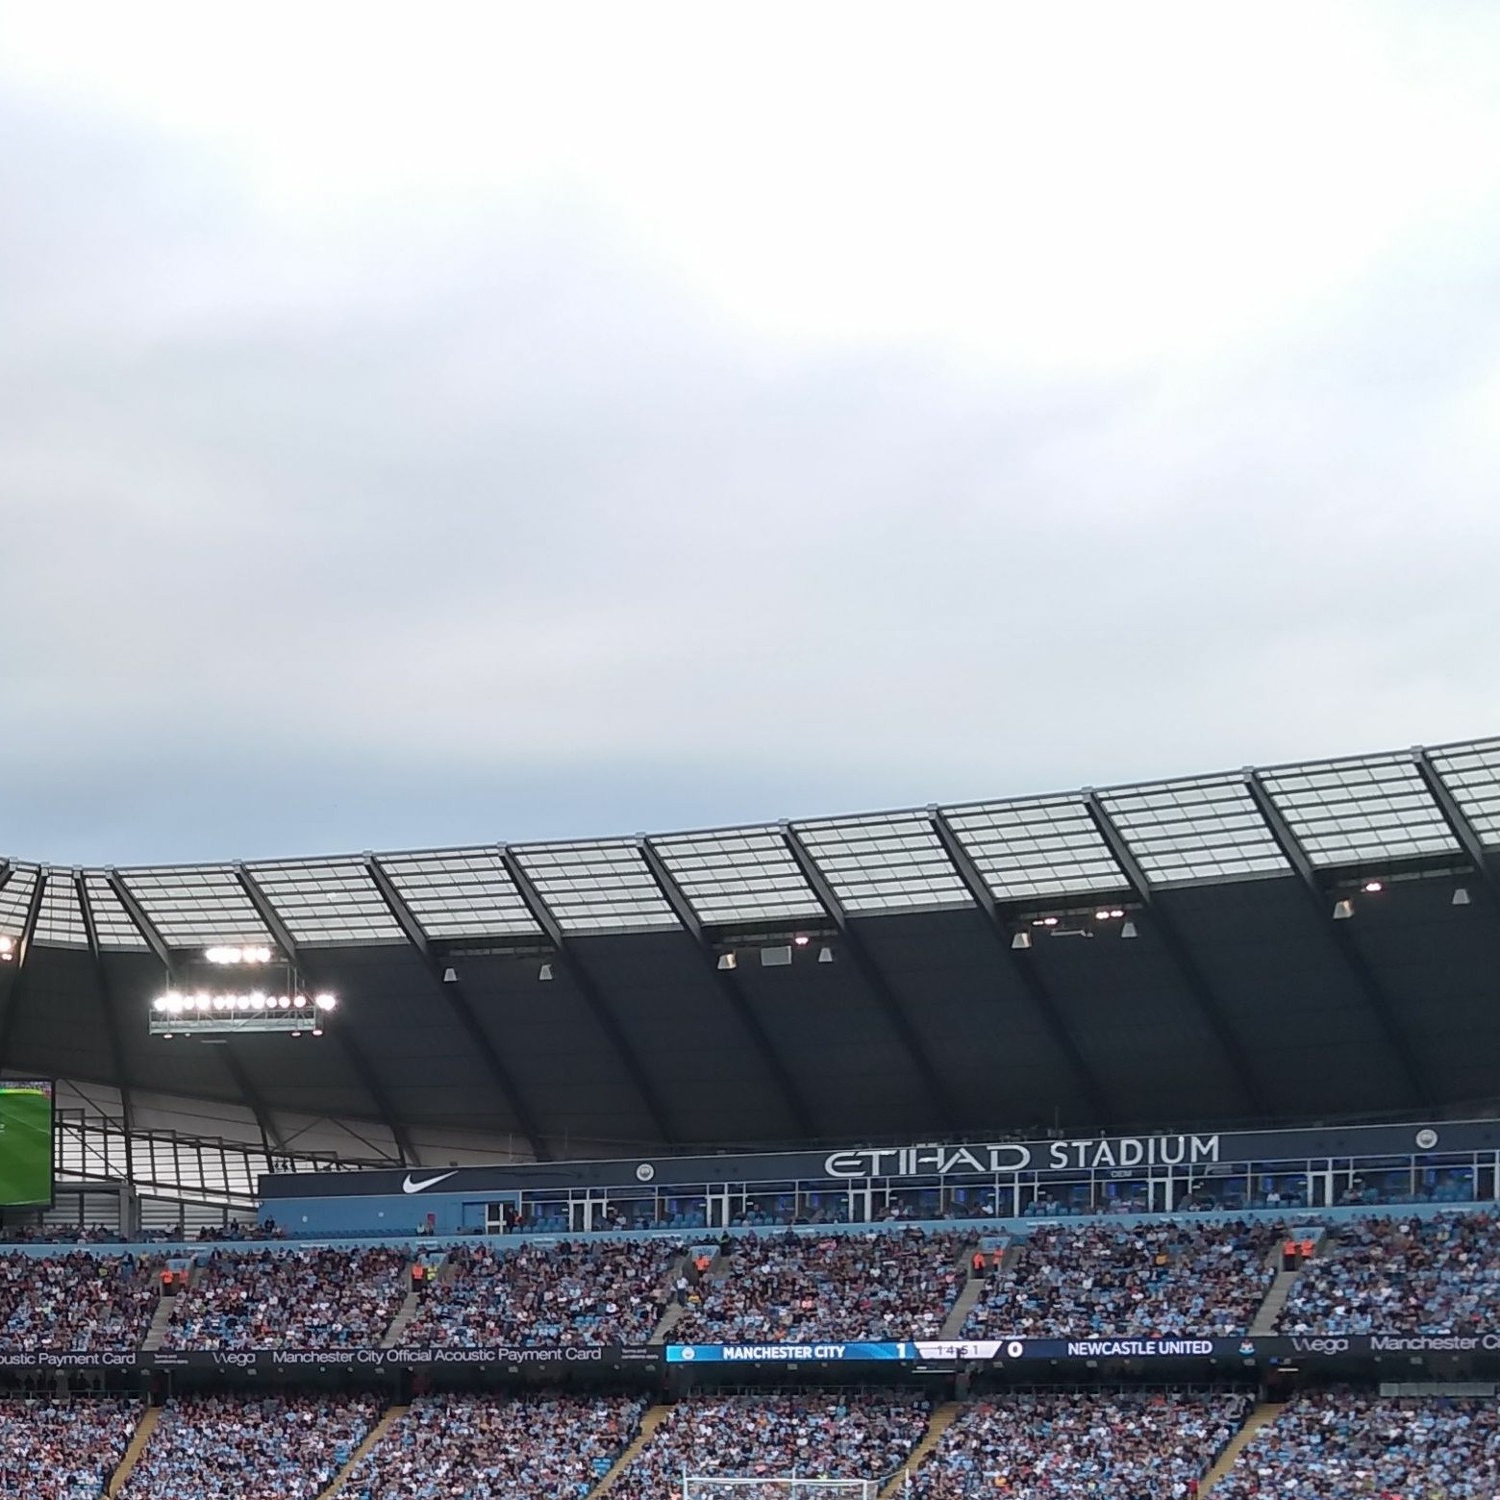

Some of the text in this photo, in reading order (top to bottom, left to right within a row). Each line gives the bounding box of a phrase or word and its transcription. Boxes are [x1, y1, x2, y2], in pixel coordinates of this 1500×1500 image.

[824, 1135, 1220, 1178] ETIHAD STADIUM
[1007, 1341, 1024, 1358] 0
[1067, 1340, 1213, 1356] NEWCASTLE UNITED
[1370, 1335, 1479, 1350] Manchester
[272, 1351, 355, 1364] Manchester
[357, 1350, 385, 1365] City
[386, 1349, 432, 1362] Official
[434, 1349, 496, 1362] Acoustic
[498, 1347, 562, 1364] Payment
[565, 1347, 602, 1361] Card
[723, 1345, 846, 1359] MANCHESTER CITY
[896, 1343, 906, 1359] 1
[38, 1352, 99, 1367] Payment
[102, 1352, 136, 1364] Card
